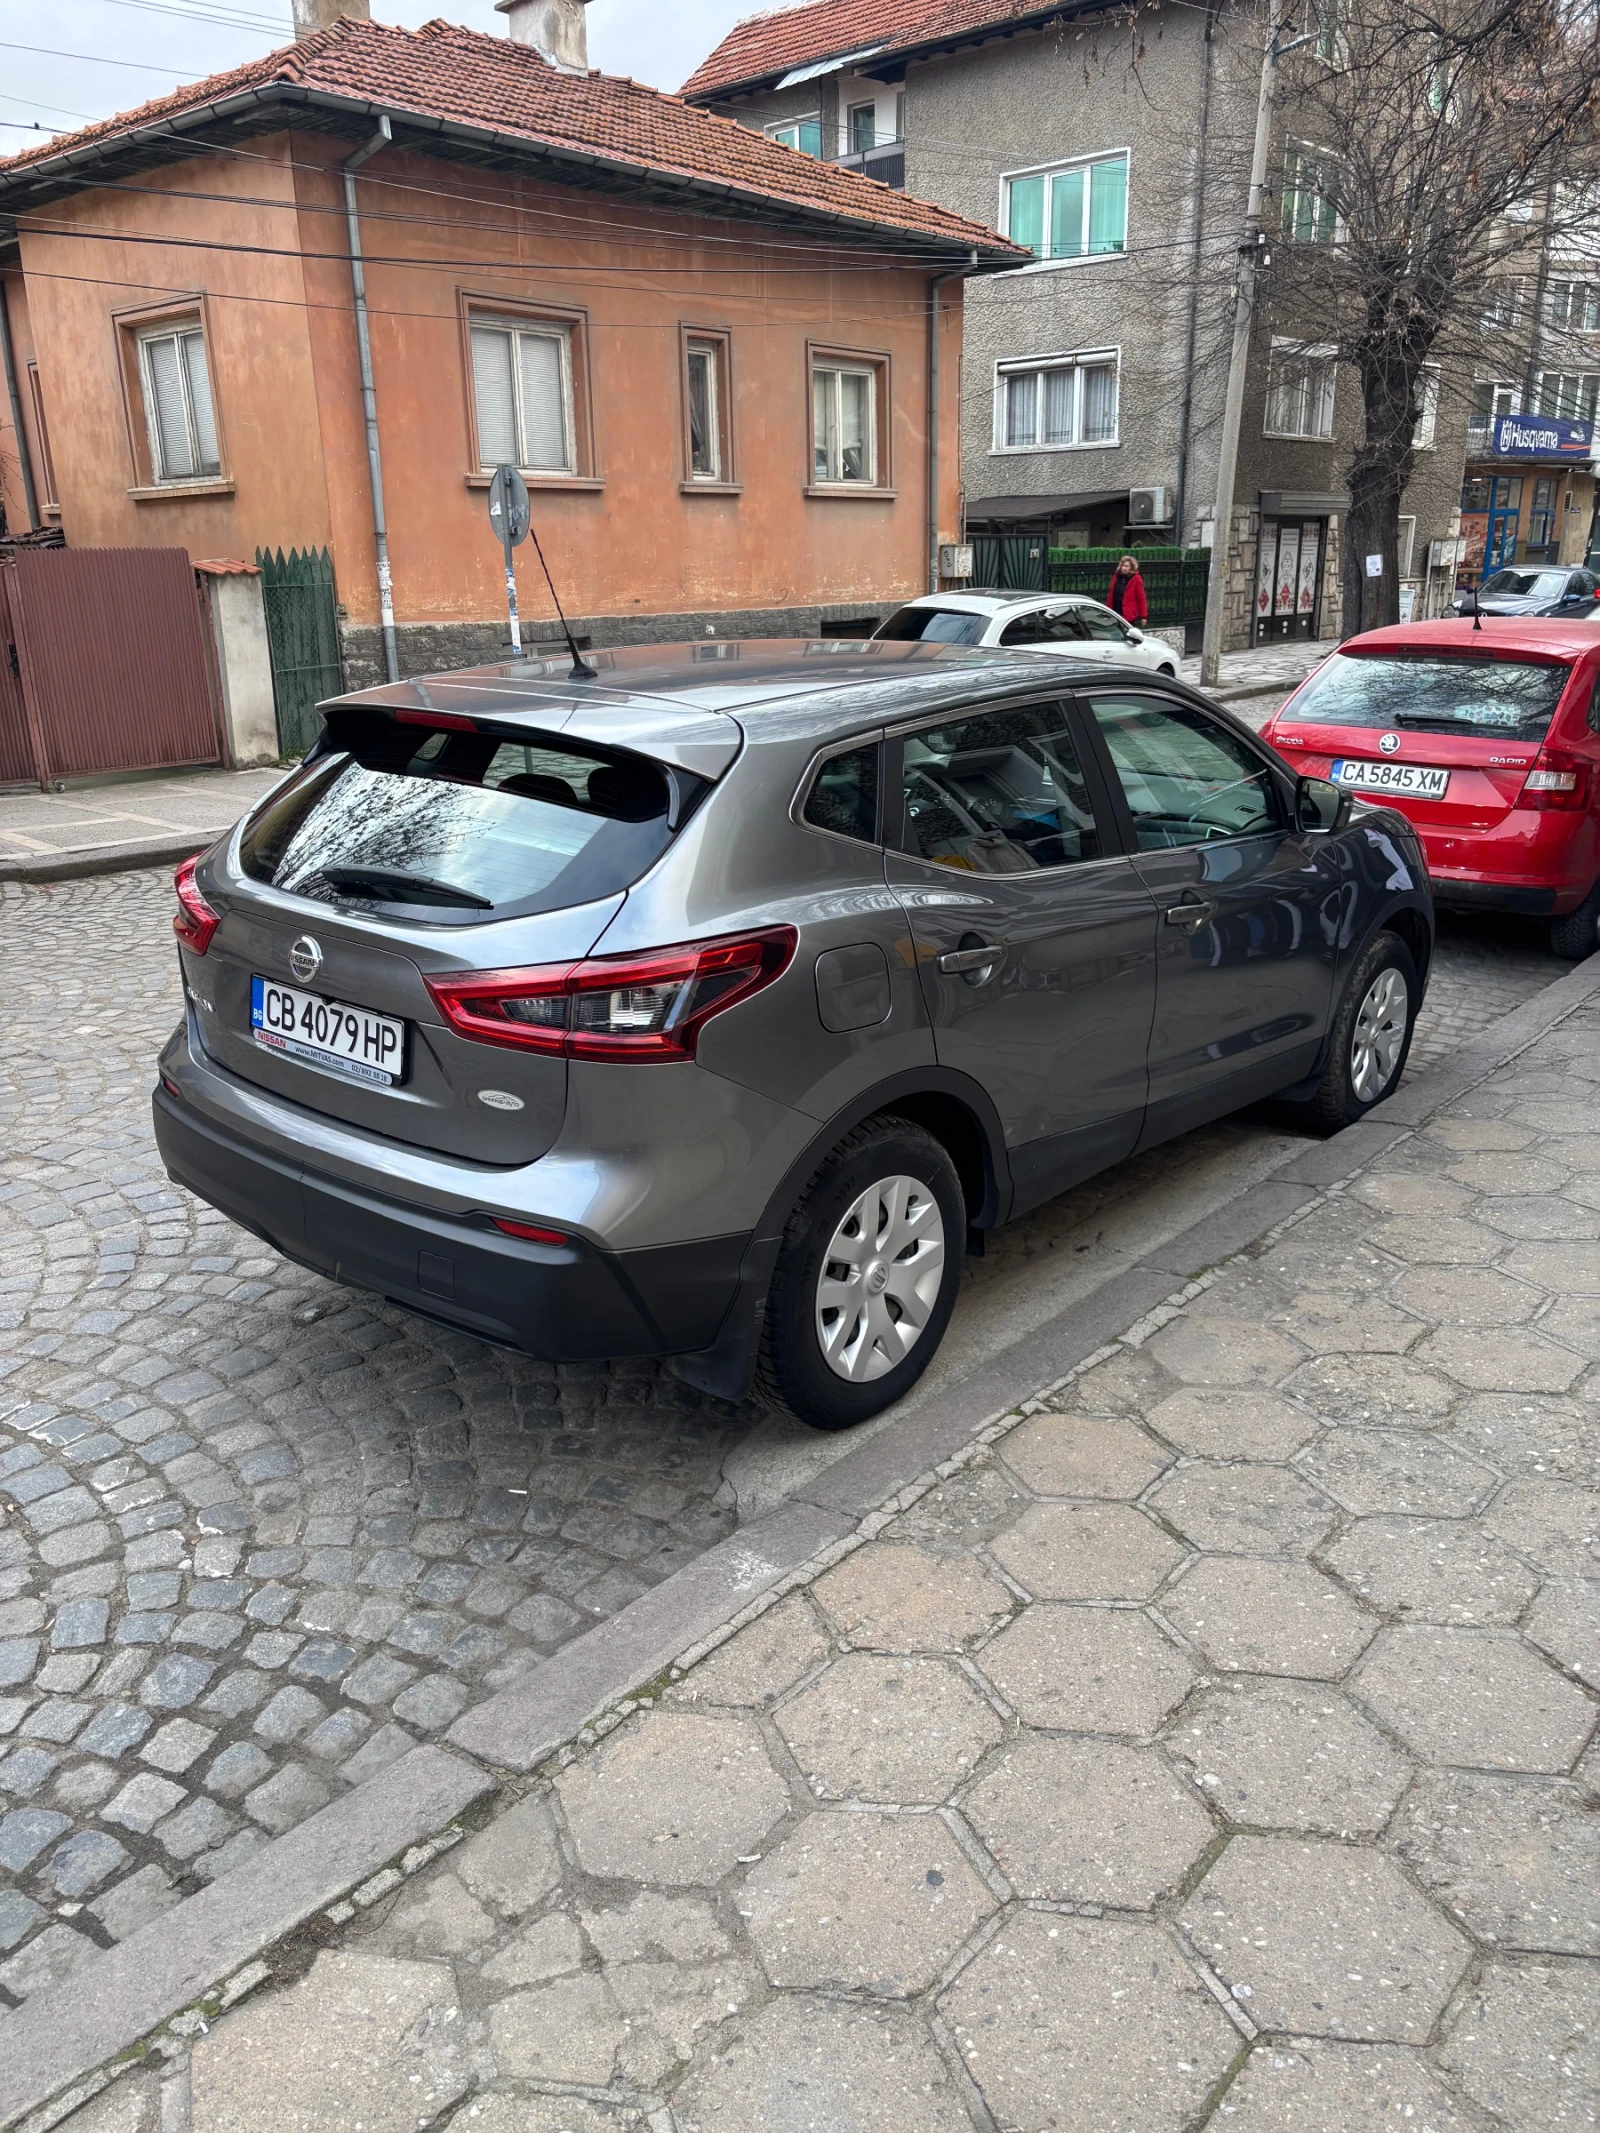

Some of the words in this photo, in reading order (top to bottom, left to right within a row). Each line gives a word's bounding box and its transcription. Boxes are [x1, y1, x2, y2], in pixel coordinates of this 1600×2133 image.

[1490, 756, 1526, 765] RAPID
[1342, 763, 1365, 782] CA
[1369, 765, 1414, 787] 5845
[1416, 770, 1444, 791] XM
[289, 952, 315, 967] NISSAN
[253, 1007, 263, 1021] BG
[266, 988, 295, 1032] CB
[300, 1001, 359, 1053] 4079
[363, 1019, 397, 1064] HP
[257, 1030, 287, 1049] NISSAN
[294, 1045, 345, 1068] www.MITVAS.com
